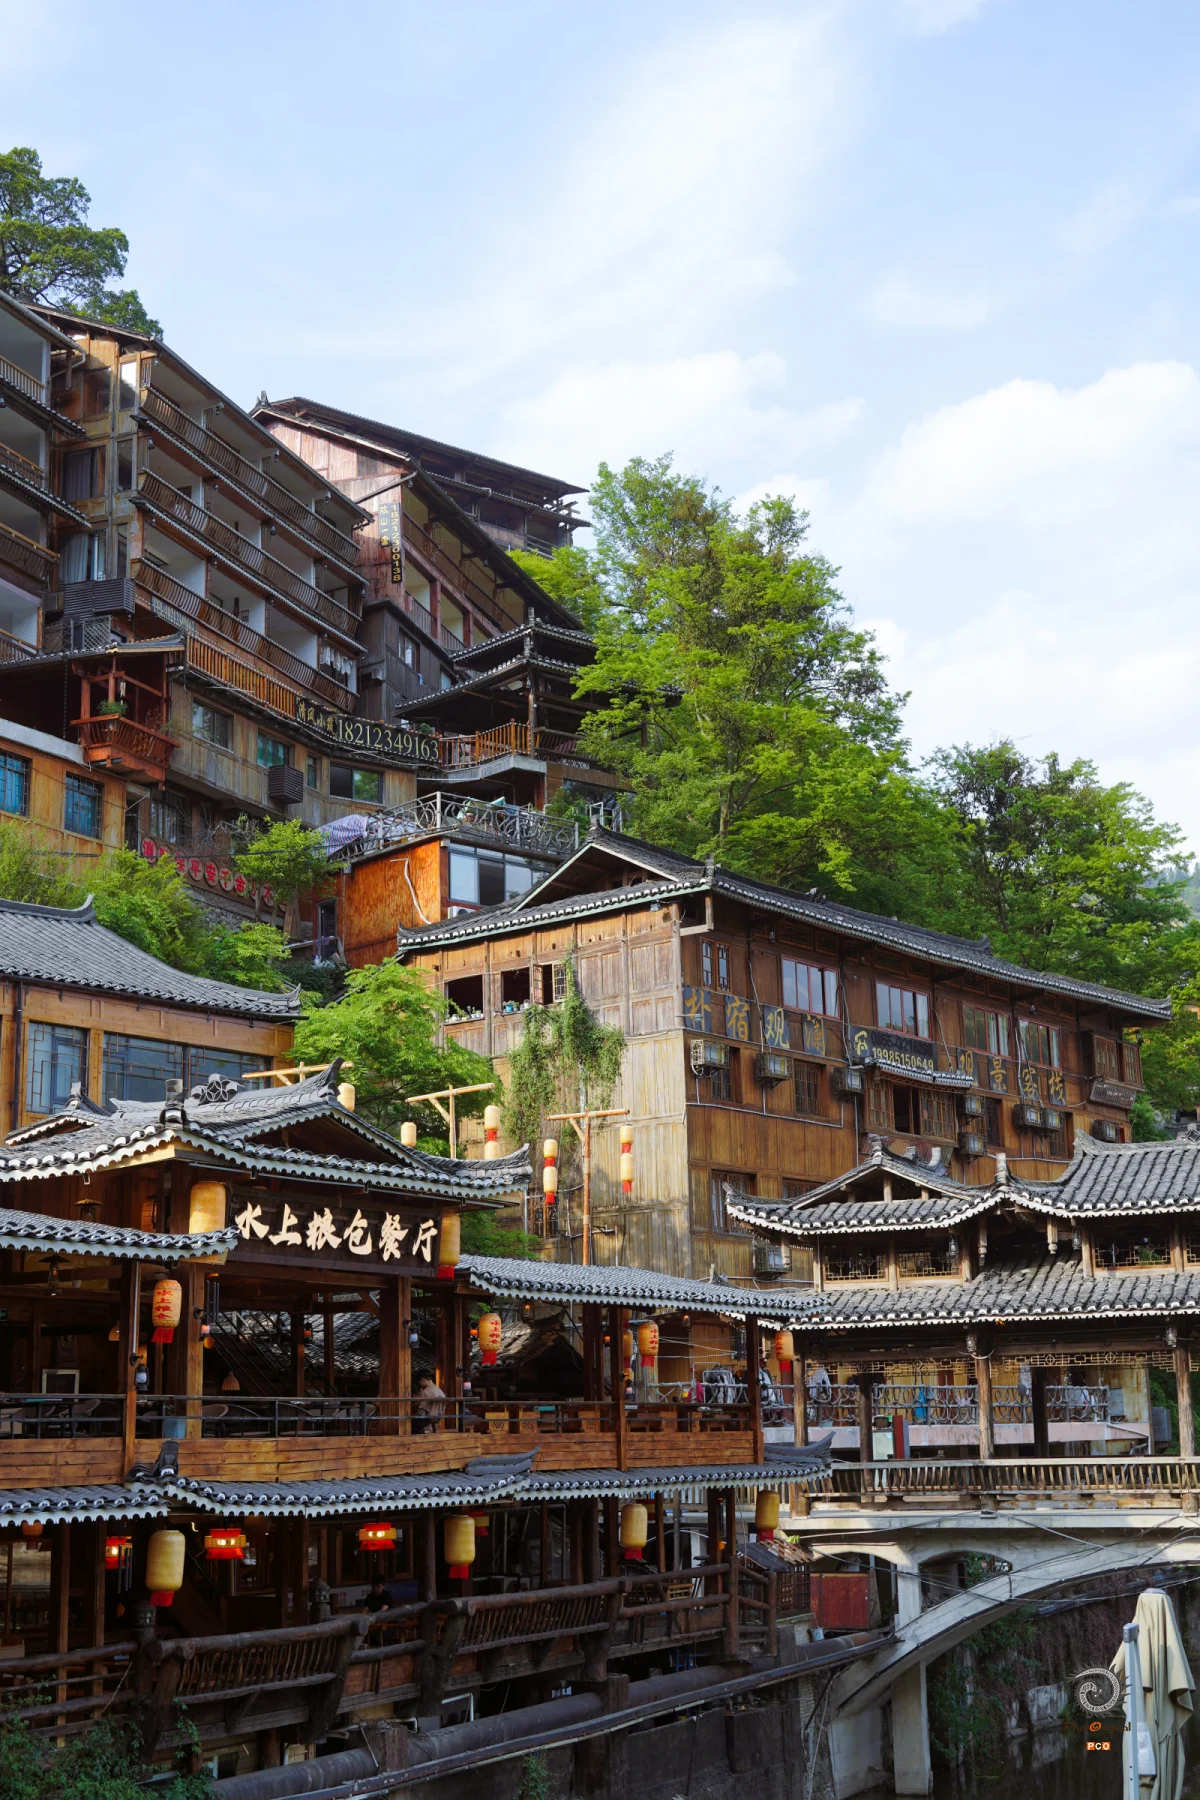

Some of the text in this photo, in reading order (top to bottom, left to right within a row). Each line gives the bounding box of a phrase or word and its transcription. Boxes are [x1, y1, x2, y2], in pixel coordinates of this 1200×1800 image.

[338, 719, 439, 760] 18212349163
[872, 1047, 934, 1072] 19985150649
[235, 1202, 438, 1262] 水上粮仓餐厅
